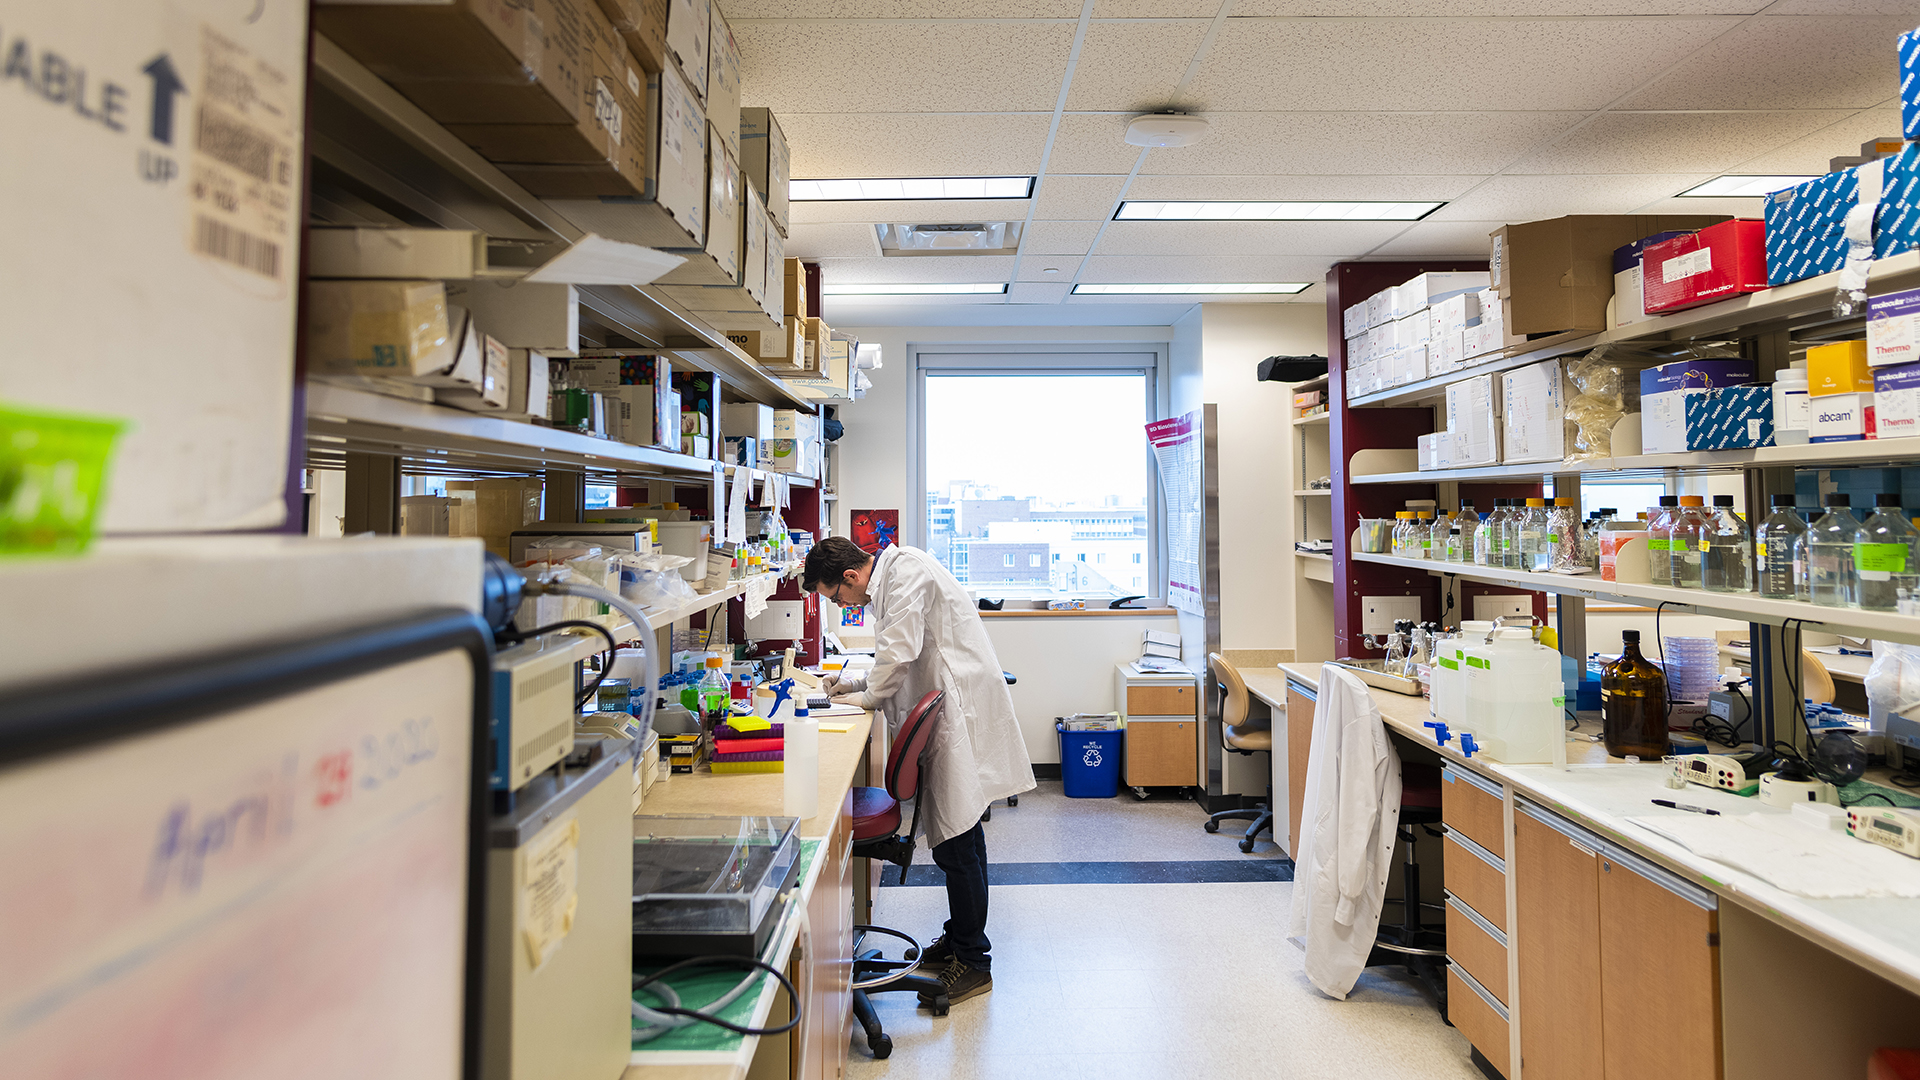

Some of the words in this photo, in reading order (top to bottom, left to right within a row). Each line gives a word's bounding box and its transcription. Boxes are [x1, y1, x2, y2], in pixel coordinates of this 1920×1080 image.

[3, 38, 127, 134] ABLE
[138, 150, 179, 184] UP
[1832, 173, 1848, 194] QIAGEN
[1881, 177, 1898, 198] QIAGEN
[1814, 188, 1828, 208] QIAGEN
[1768, 206, 1782, 226] QIAGEN
[1796, 202, 1810, 222] QIAGEN
[1826, 198, 1842, 218] QIAGEN
[1780, 216, 1792, 234] QIAGEN
[1808, 212, 1822, 232] QIAGEN
[1888, 214, 1906, 234] QIAGEN
[1790, 226, 1804, 244] QIAGEN
[1820, 222, 1835, 242] QIAGEN
[1774, 239, 1788, 258] QIAGEN
[1802, 236, 1817, 254] QIAGEN
[1785, 248, 1799, 268] QIAGEN
[1816, 246, 1830, 265] QIAGEN
[1769, 261, 1782, 280] QIAGEN
[1797, 259, 1812, 278] QIAGEN
[1696, 284, 1734, 297] SIGMA-ALDRICH
[1871, 298, 1905, 310] molecular
[1875, 345, 1911, 354] Thermo
[1877, 372, 1908, 382] molecular
[1726, 394, 1738, 410] QIAGEN
[1744, 386, 1758, 400] QIAGEN
[1688, 402, 1698, 417] QIAGEN
[1711, 403, 1723, 419] QIAGEN
[1737, 406, 1752, 422] QIAGEN
[1756, 398, 1771, 413] QIAGEN
[1697, 412, 1708, 428] QIAGEN
[1722, 414, 1734, 430] QIAGEN
[1818, 412, 1850, 423] abcam
[1882, 418, 1915, 426] Thermo
[1692, 432, 1704, 448] QIAGEN
[1706, 424, 1718, 439] QIAGEN
[1732, 426, 1746, 442] QIAGEN
[1082, 576, 1088, 586] 6
[142, 750, 300, 900] April
